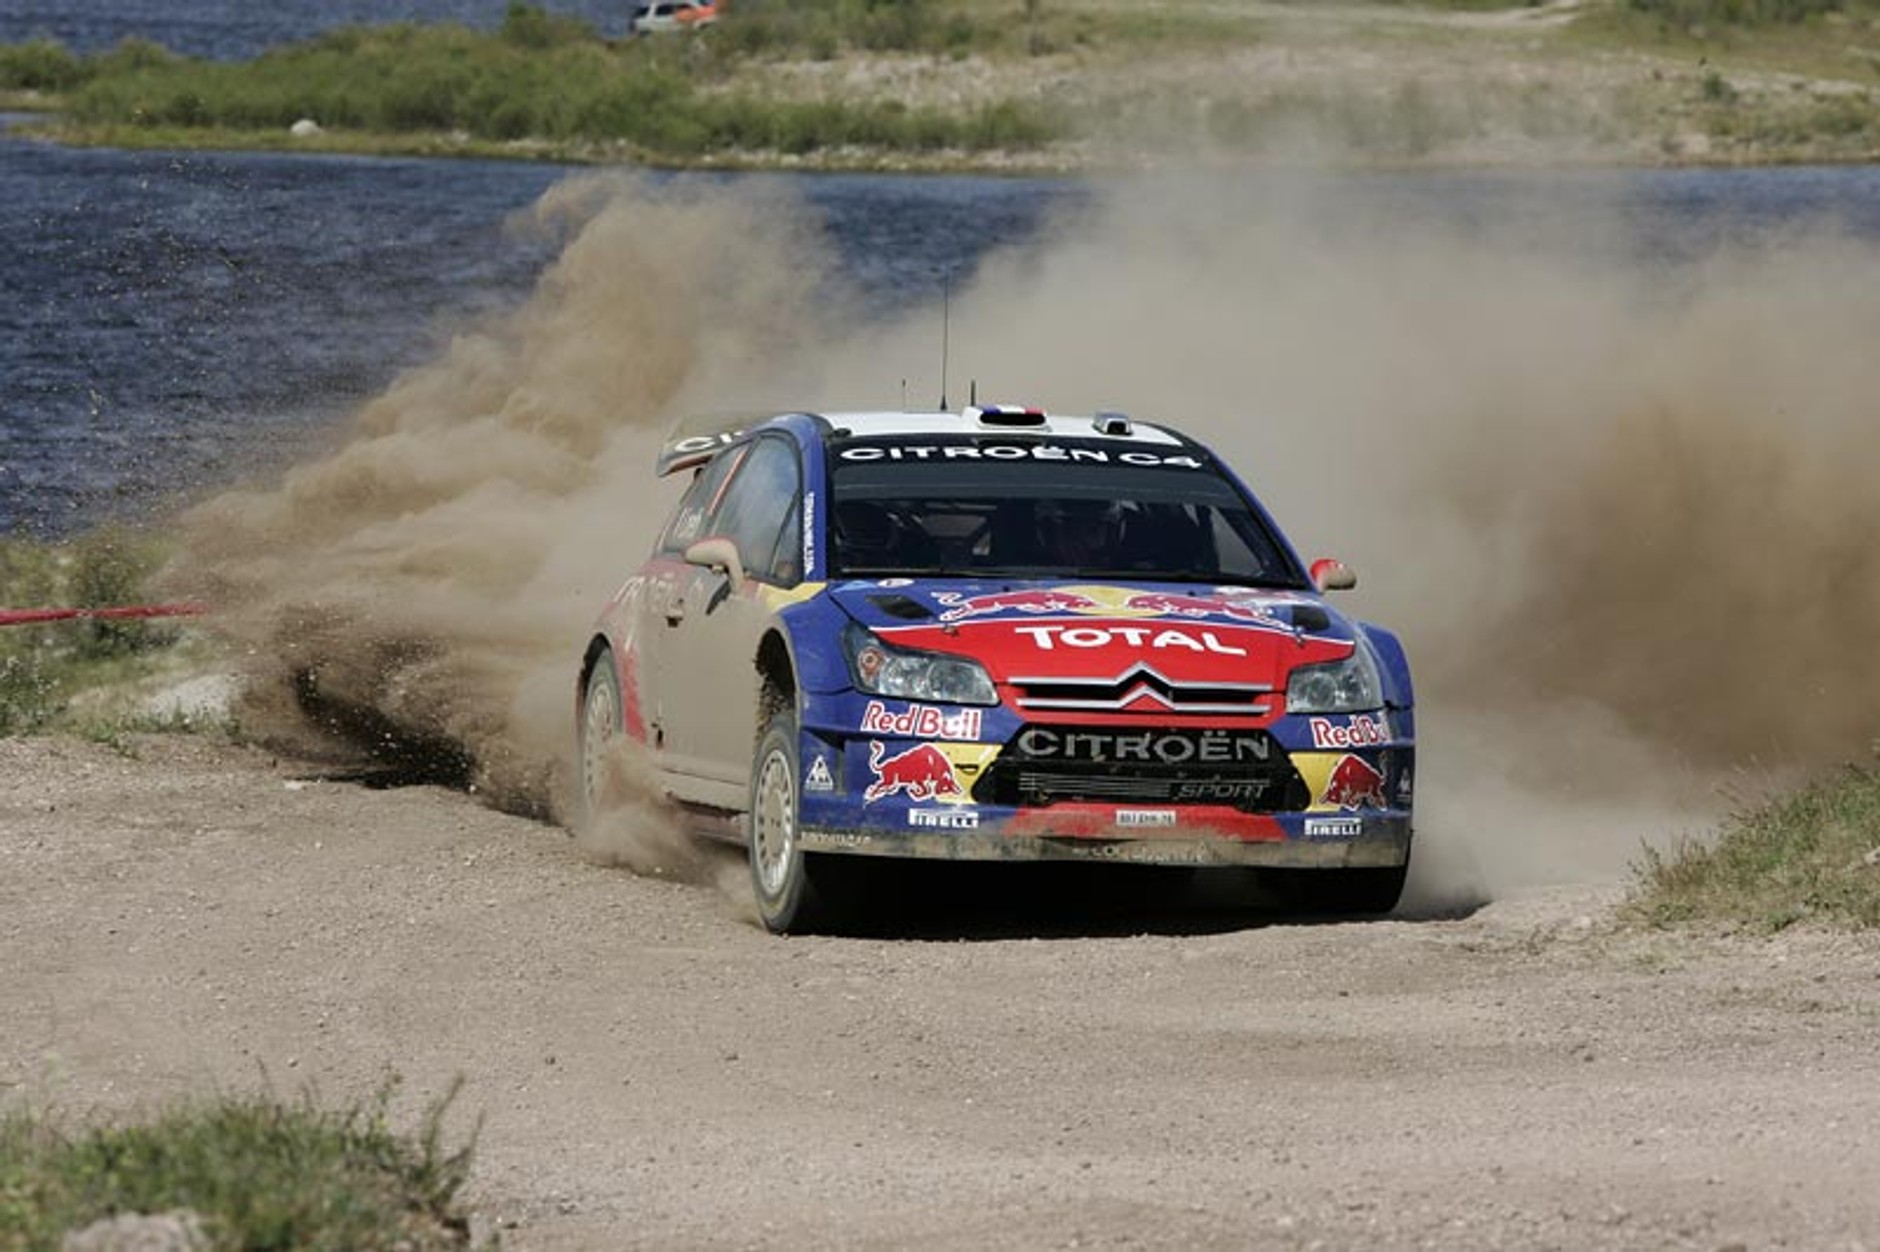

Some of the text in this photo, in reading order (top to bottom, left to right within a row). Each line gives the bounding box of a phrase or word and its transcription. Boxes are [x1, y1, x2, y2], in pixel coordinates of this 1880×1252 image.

[674, 432, 745, 451] CI
[840, 446, 1202, 468] CITROËN C4
[1014, 626, 1247, 656] TOTAL
[860, 701, 982, 740] Red Bull
[1309, 716, 1362, 748] Red
[1018, 729, 1269, 762] CITROËN
[1177, 781, 1269, 799] SPORT
[909, 808, 979, 828] PIRELLI
[1304, 817, 1361, 835] PIRELLI
